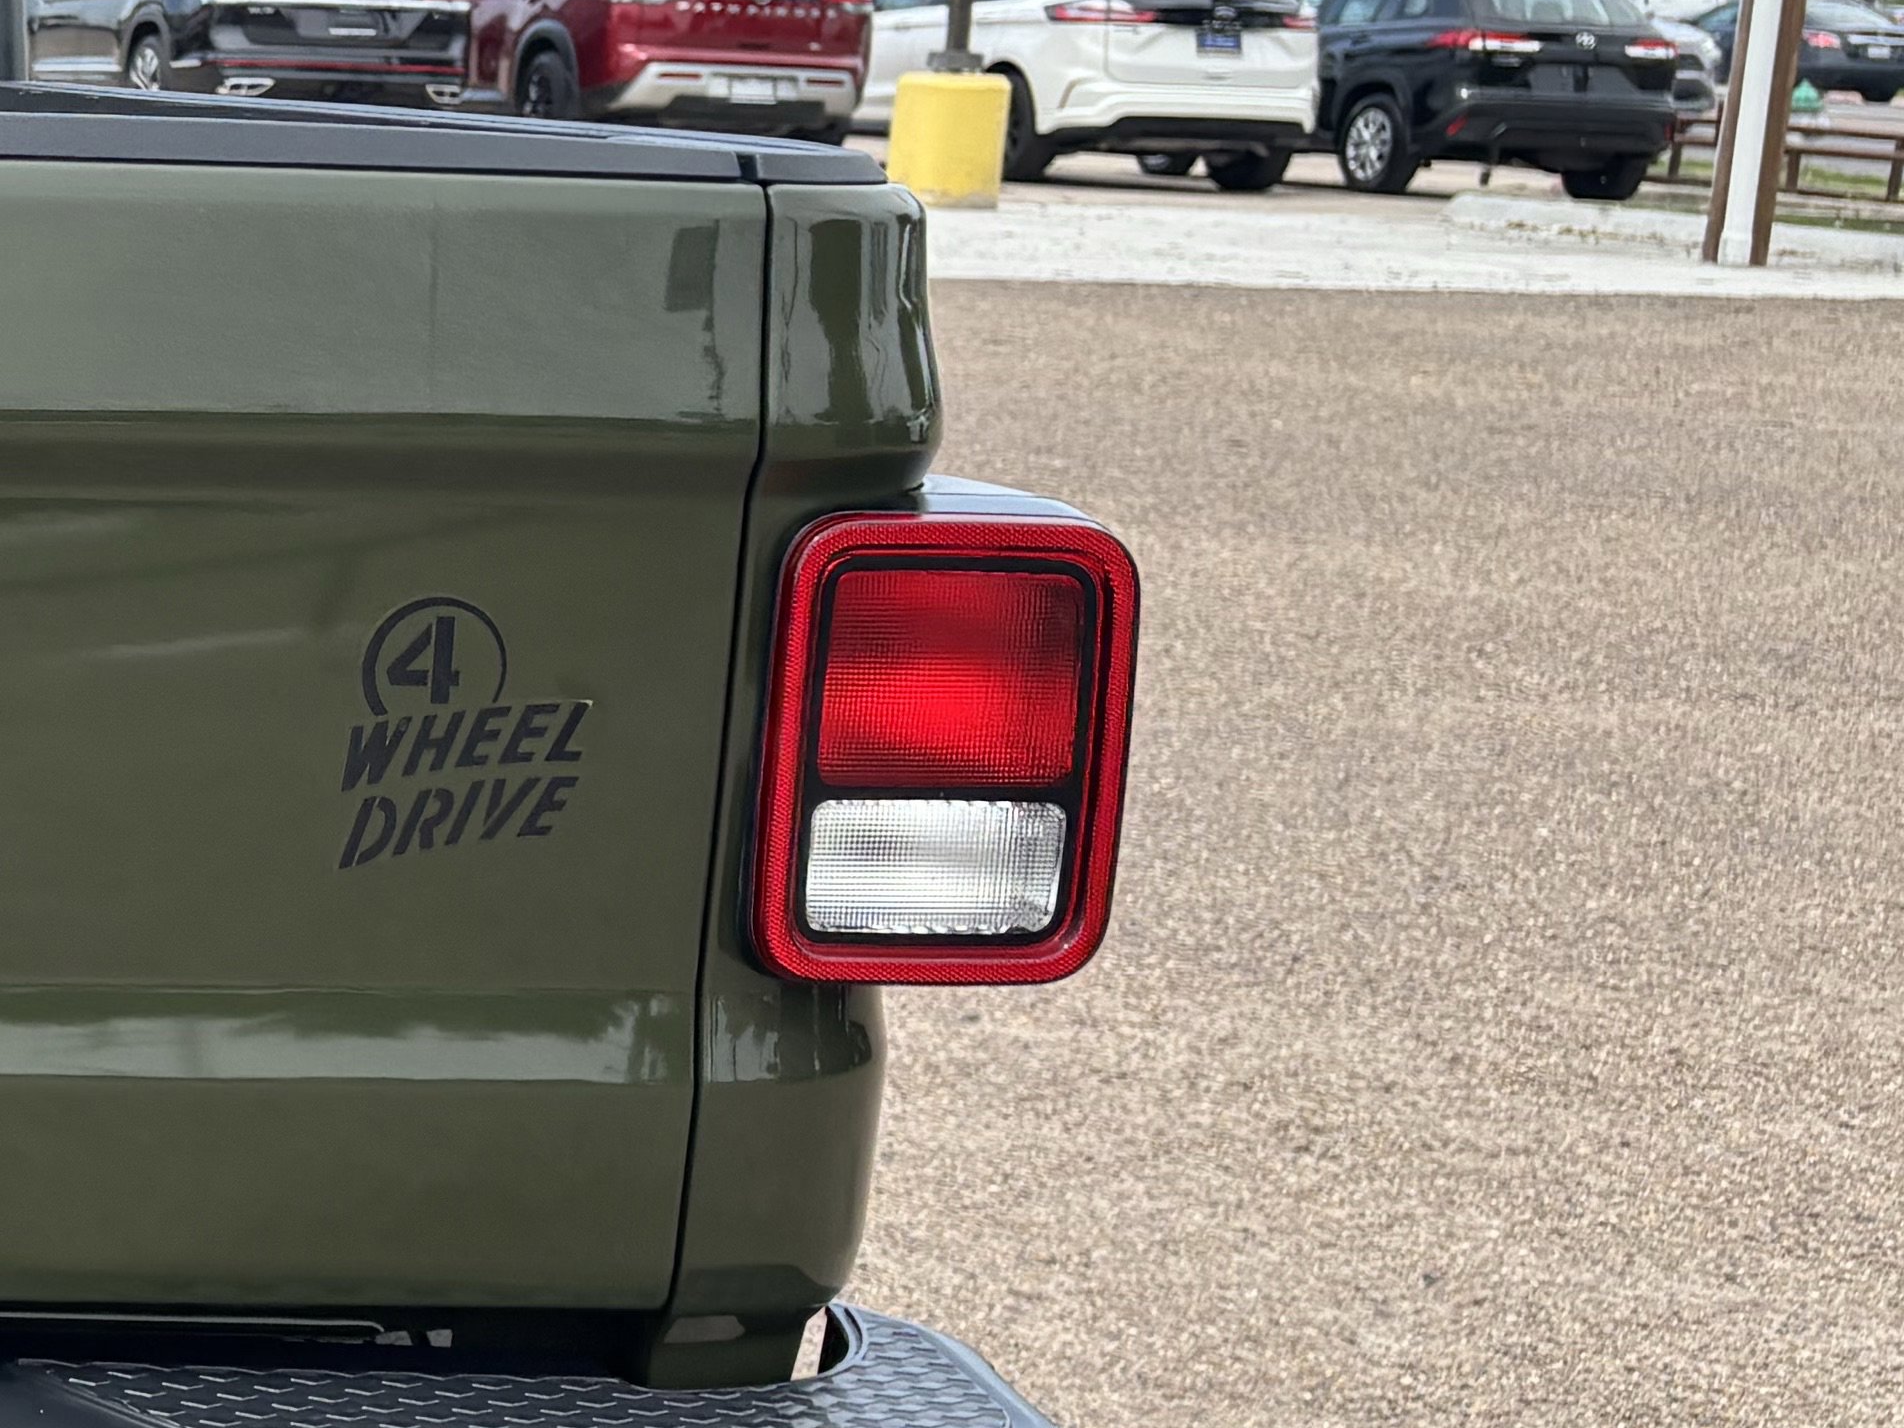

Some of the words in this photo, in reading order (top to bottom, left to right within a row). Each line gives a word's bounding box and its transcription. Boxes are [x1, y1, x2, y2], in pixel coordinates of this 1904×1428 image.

[386, 615, 461, 705] 4
[340, 699, 594, 793] WHEEL
[337, 775, 580, 870] DRIVE
